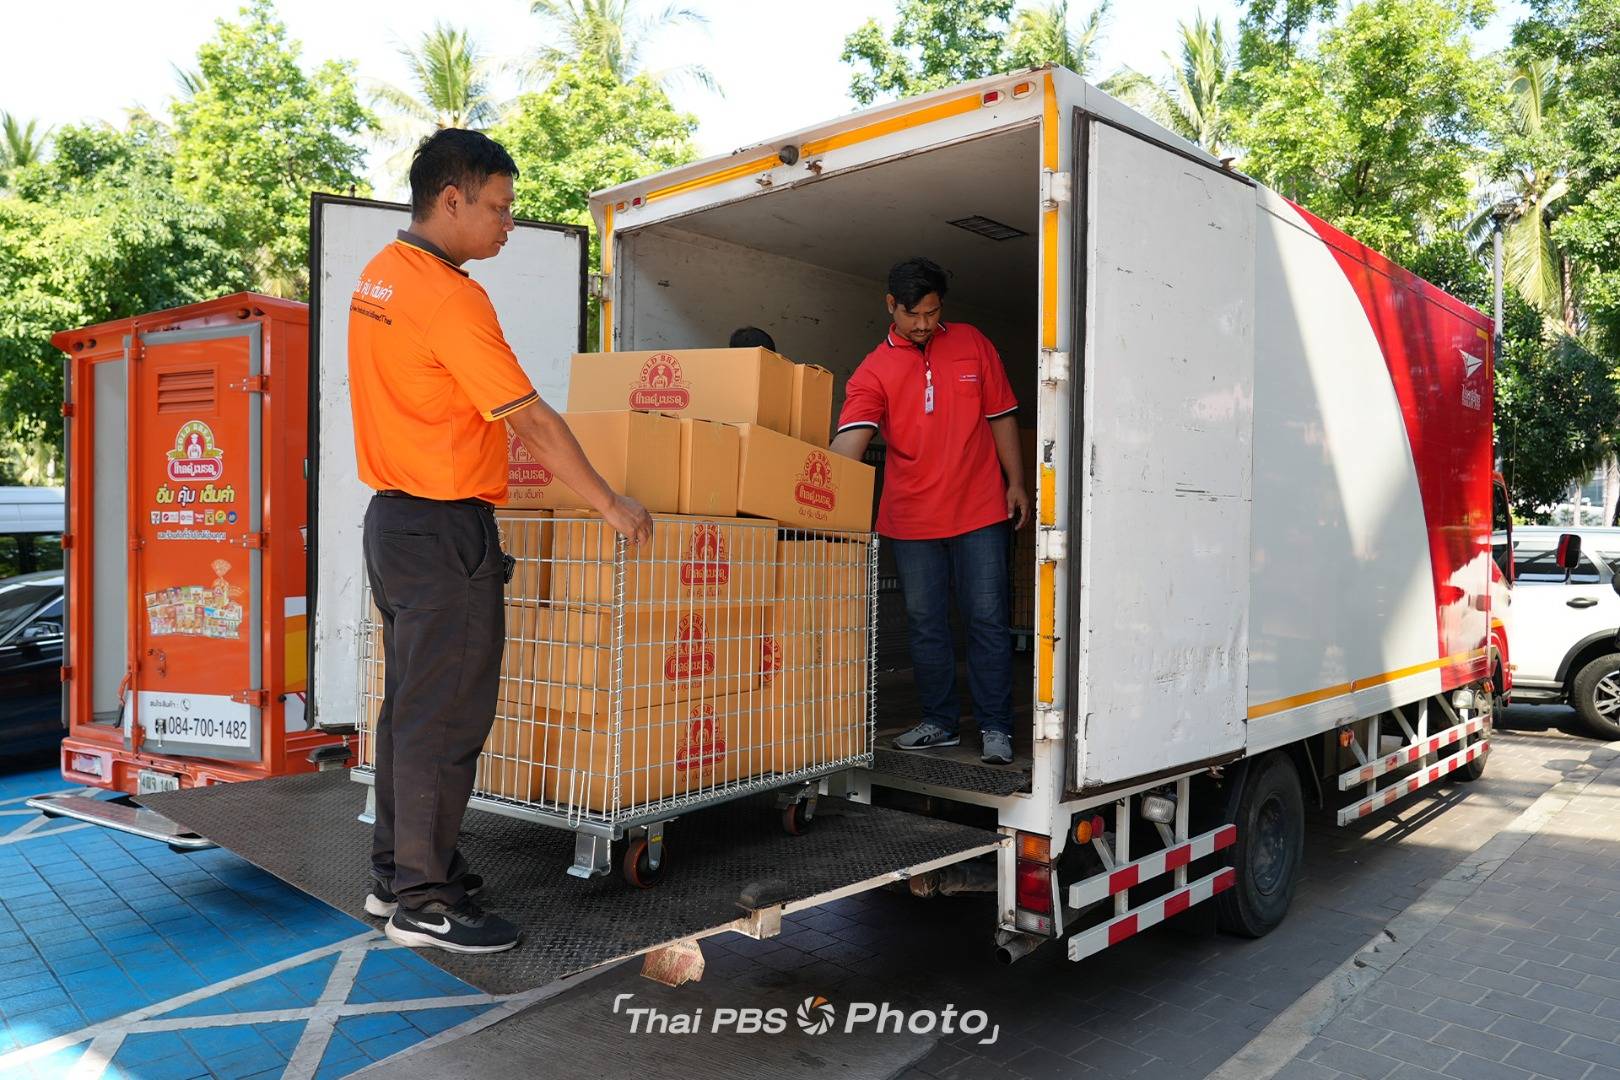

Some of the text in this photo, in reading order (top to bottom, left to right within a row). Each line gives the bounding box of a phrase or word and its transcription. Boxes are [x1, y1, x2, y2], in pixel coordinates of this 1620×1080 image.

[641, 355, 681, 382] GOLD BREAD
[156, 484, 235, 507] อิ่ม คุ้ม เต็มคำ
[168, 716, 247, 740] 084-700-1482
